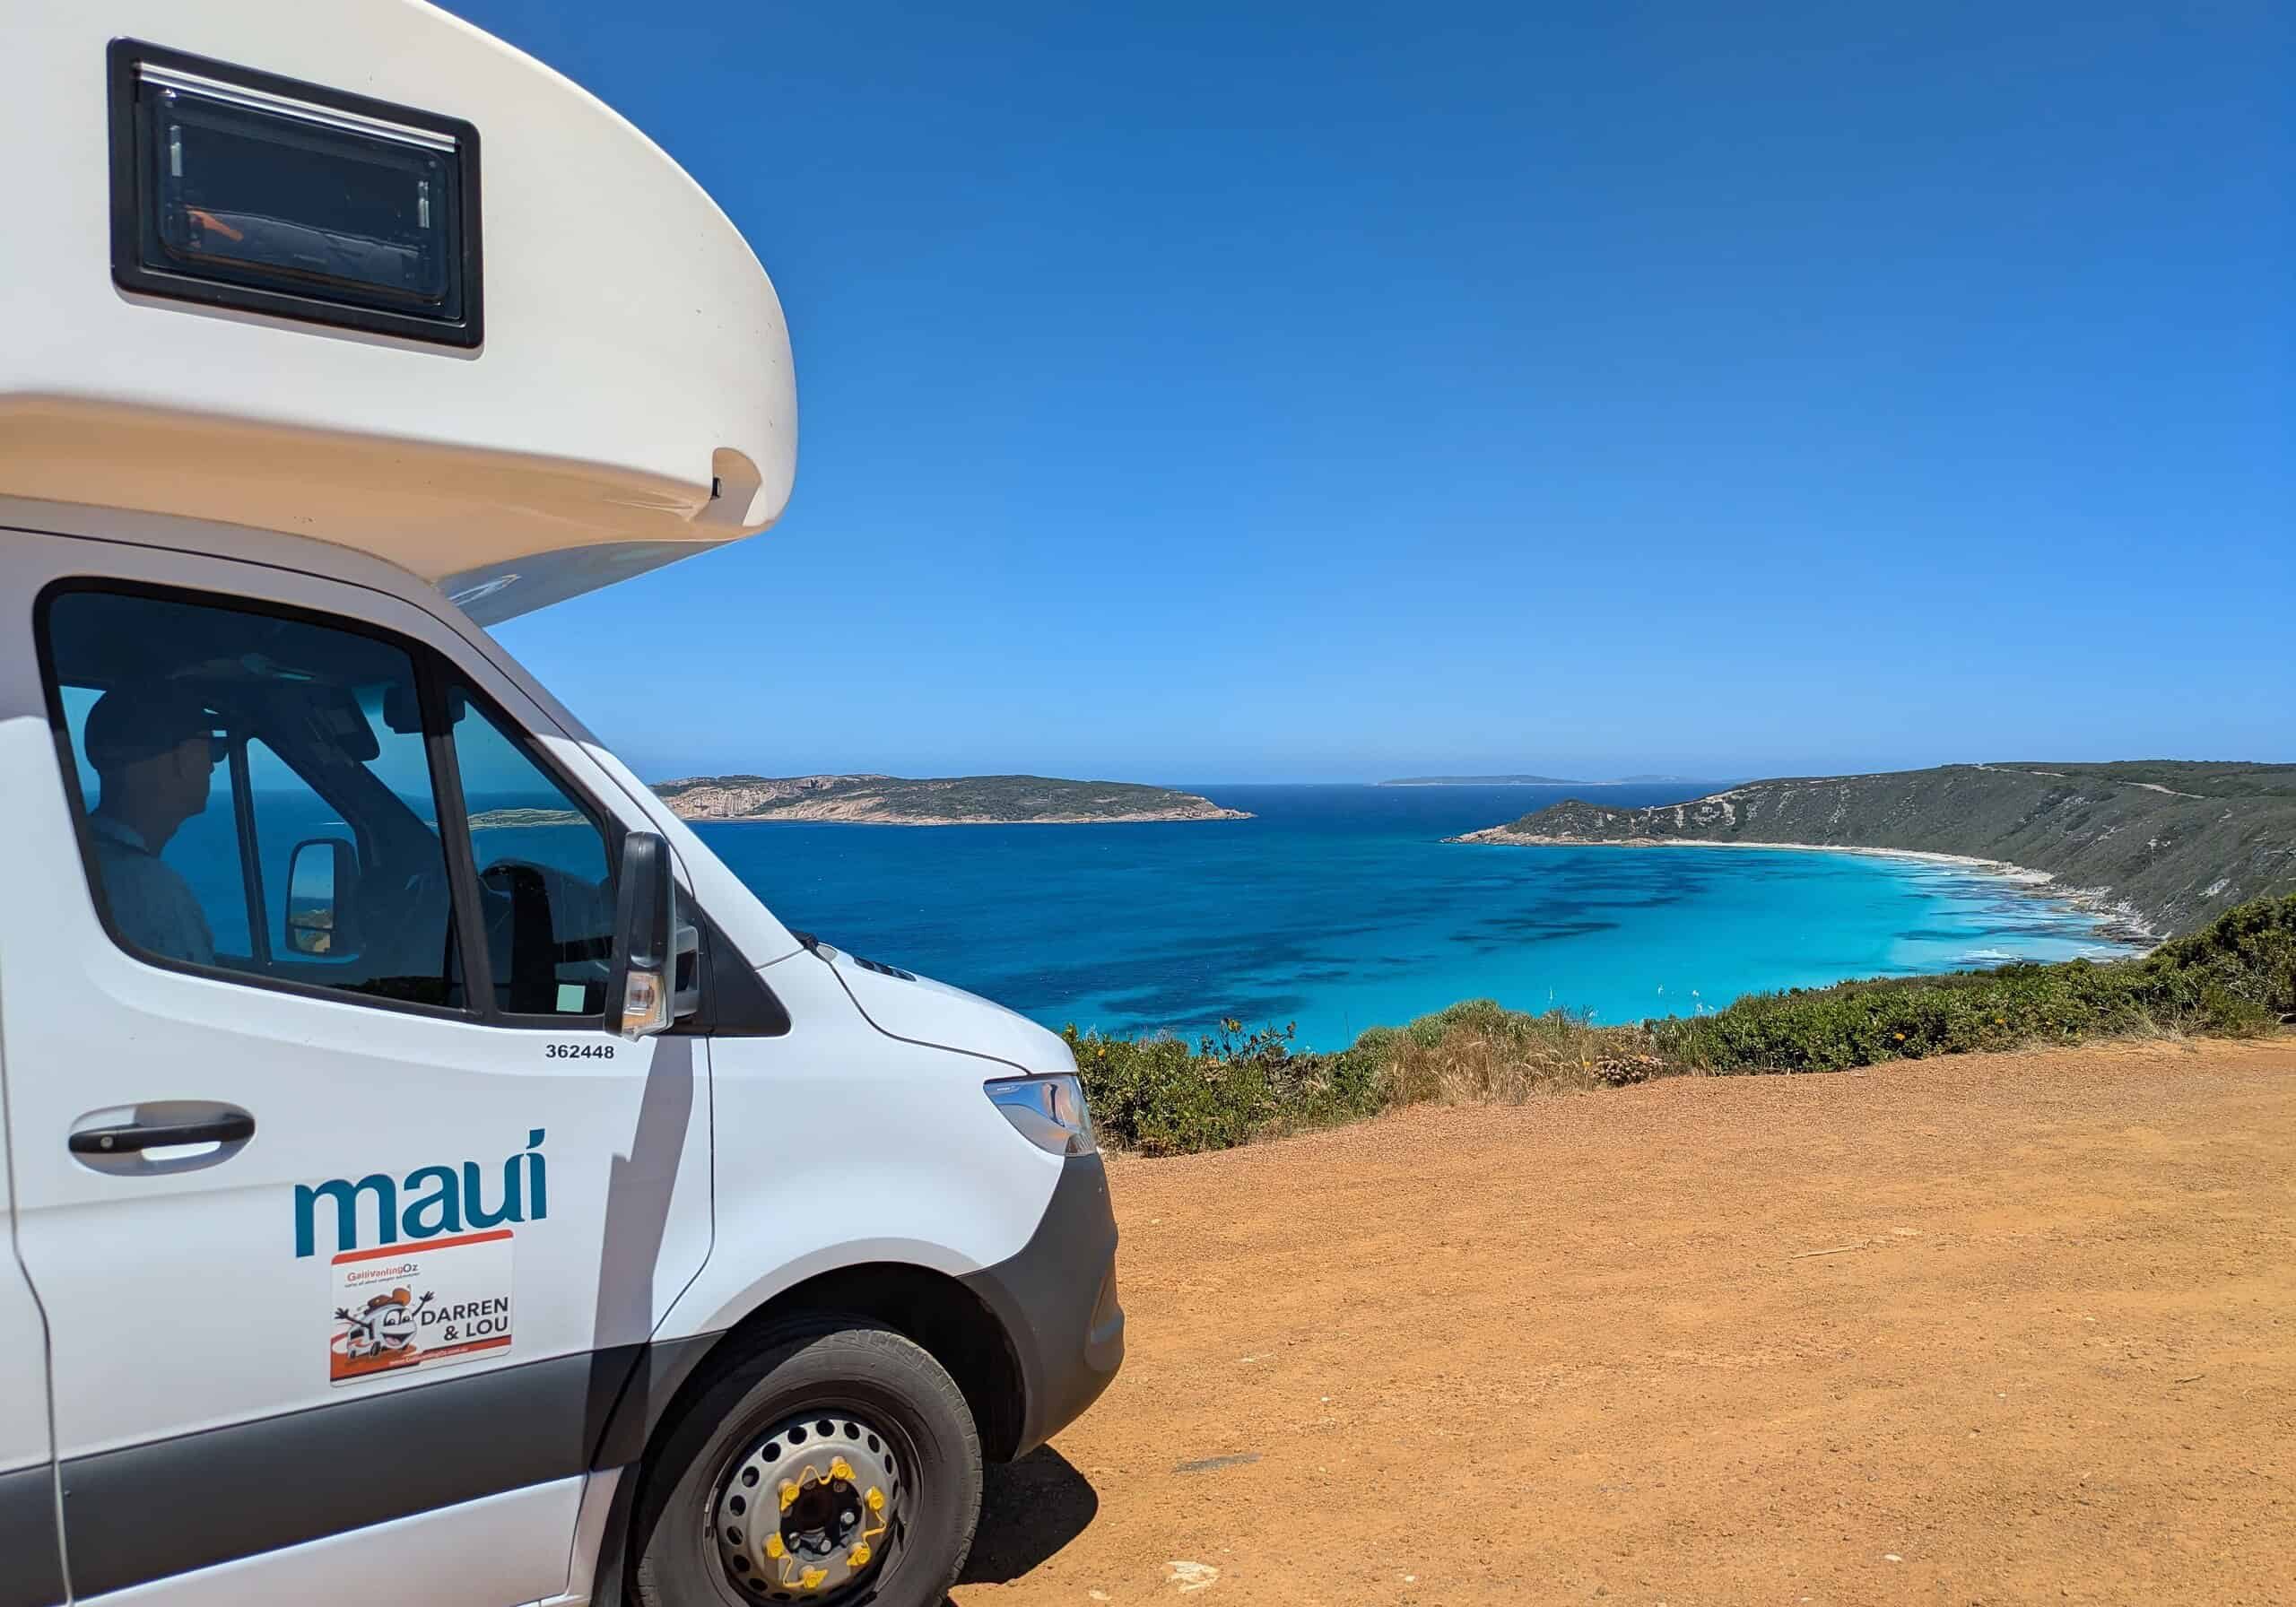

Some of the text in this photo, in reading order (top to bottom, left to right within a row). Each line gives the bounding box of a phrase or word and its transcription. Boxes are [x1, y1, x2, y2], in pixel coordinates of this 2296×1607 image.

[545, 1044, 614, 1059] 362448
[294, 1128, 547, 1258] maui
[421, 1297, 509, 1326] DARREN
[444, 1316, 508, 1341] & LOU
